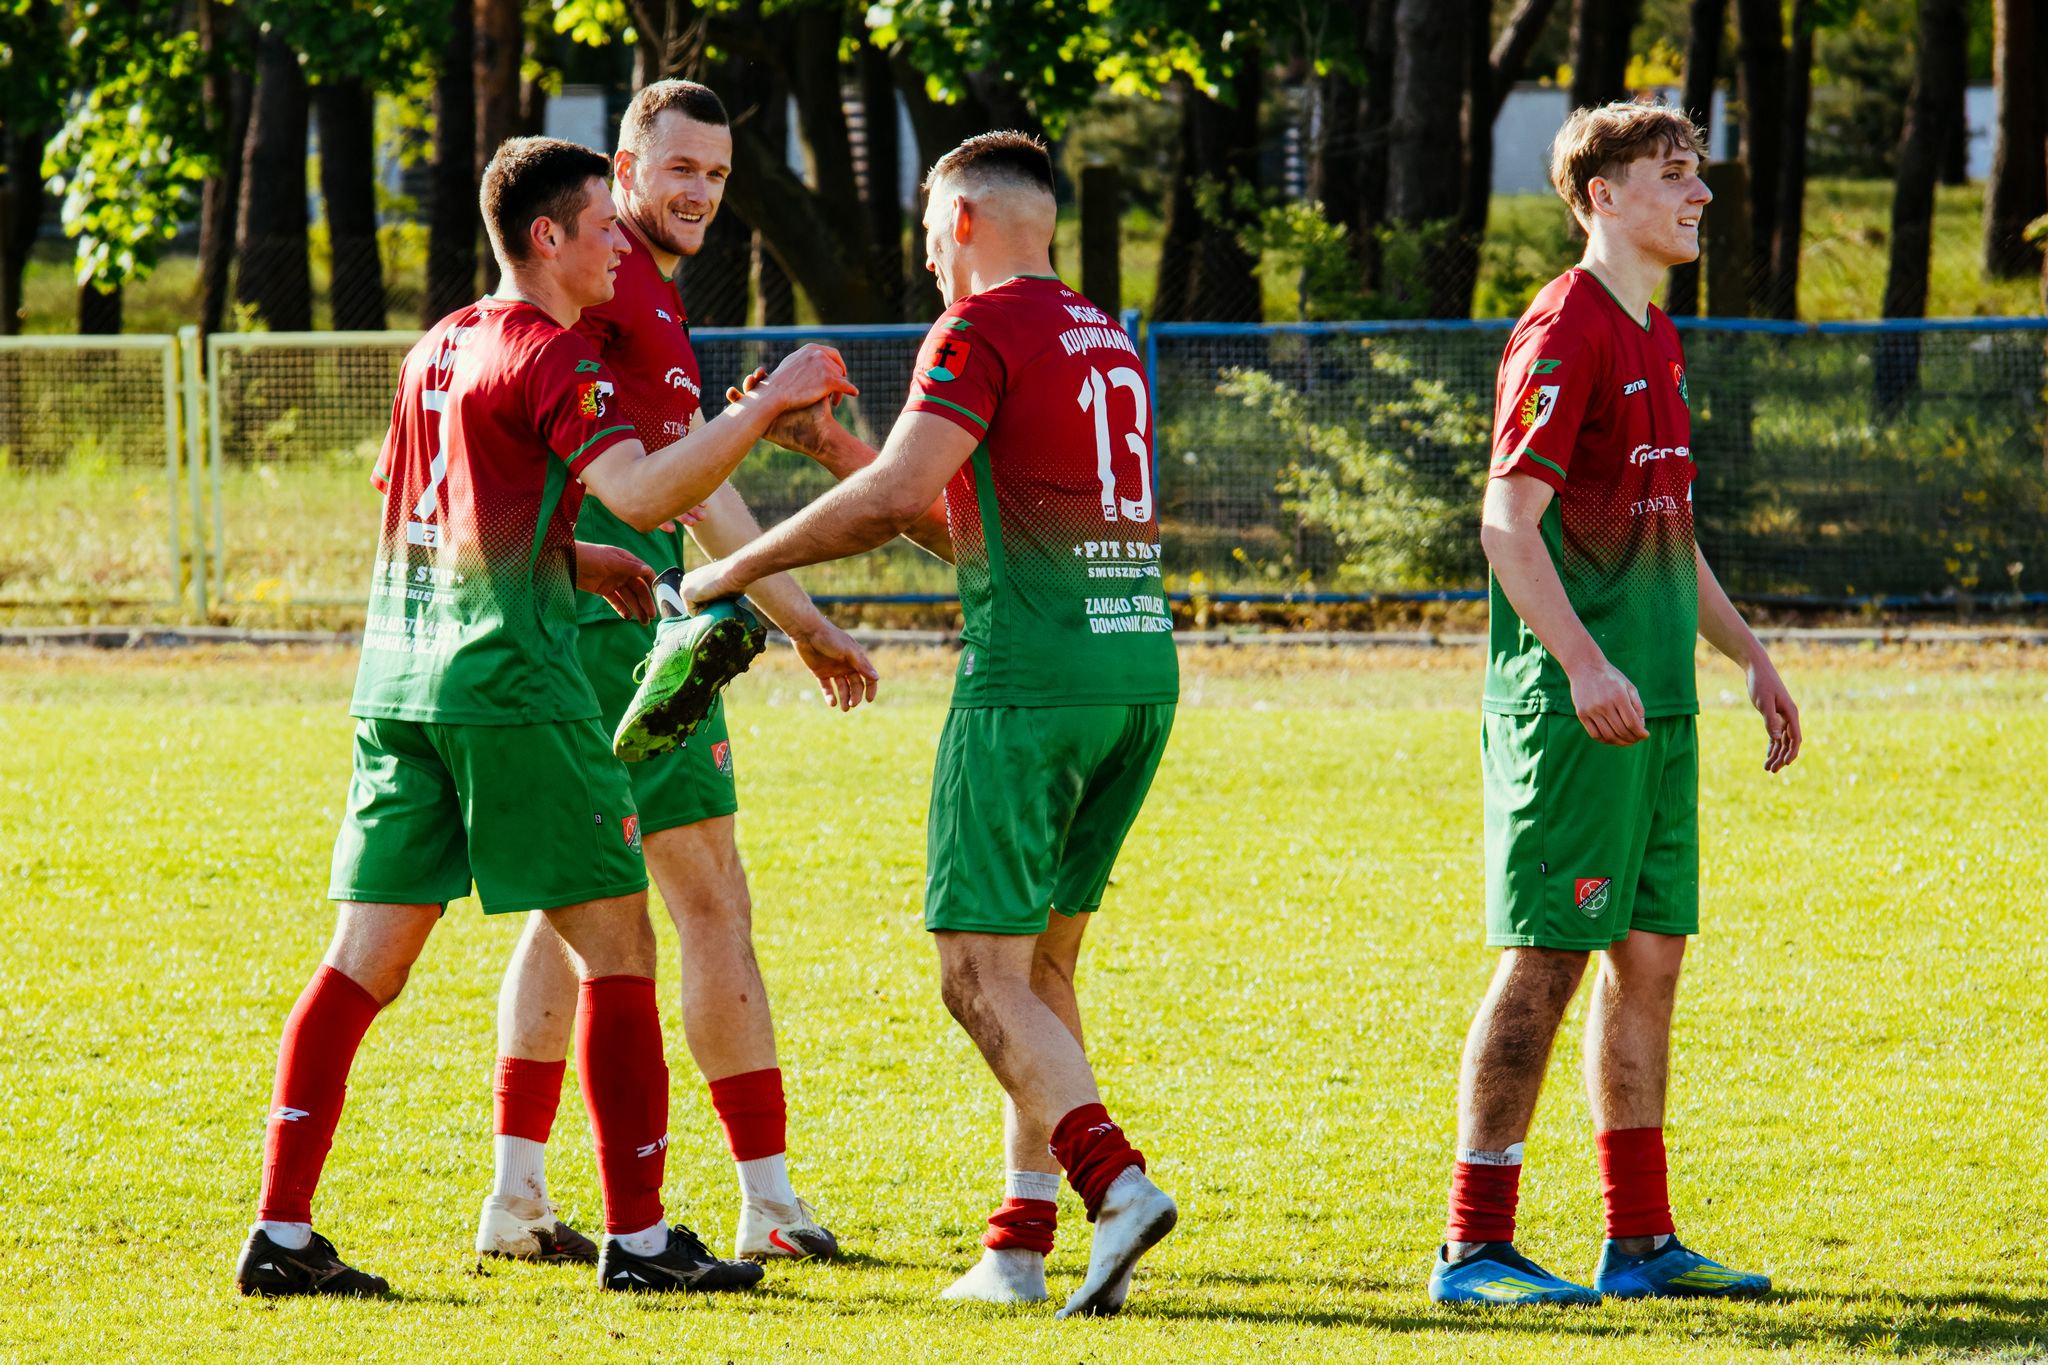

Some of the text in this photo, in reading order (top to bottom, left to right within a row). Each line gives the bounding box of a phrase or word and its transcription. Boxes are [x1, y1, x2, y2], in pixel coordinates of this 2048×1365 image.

[1077, 366, 1152, 522] 13
[1083, 541, 1120, 559] PIT
[1084, 597, 1131, 615] ZAKŁAD
[1089, 615, 1140, 634] DOMINIK
